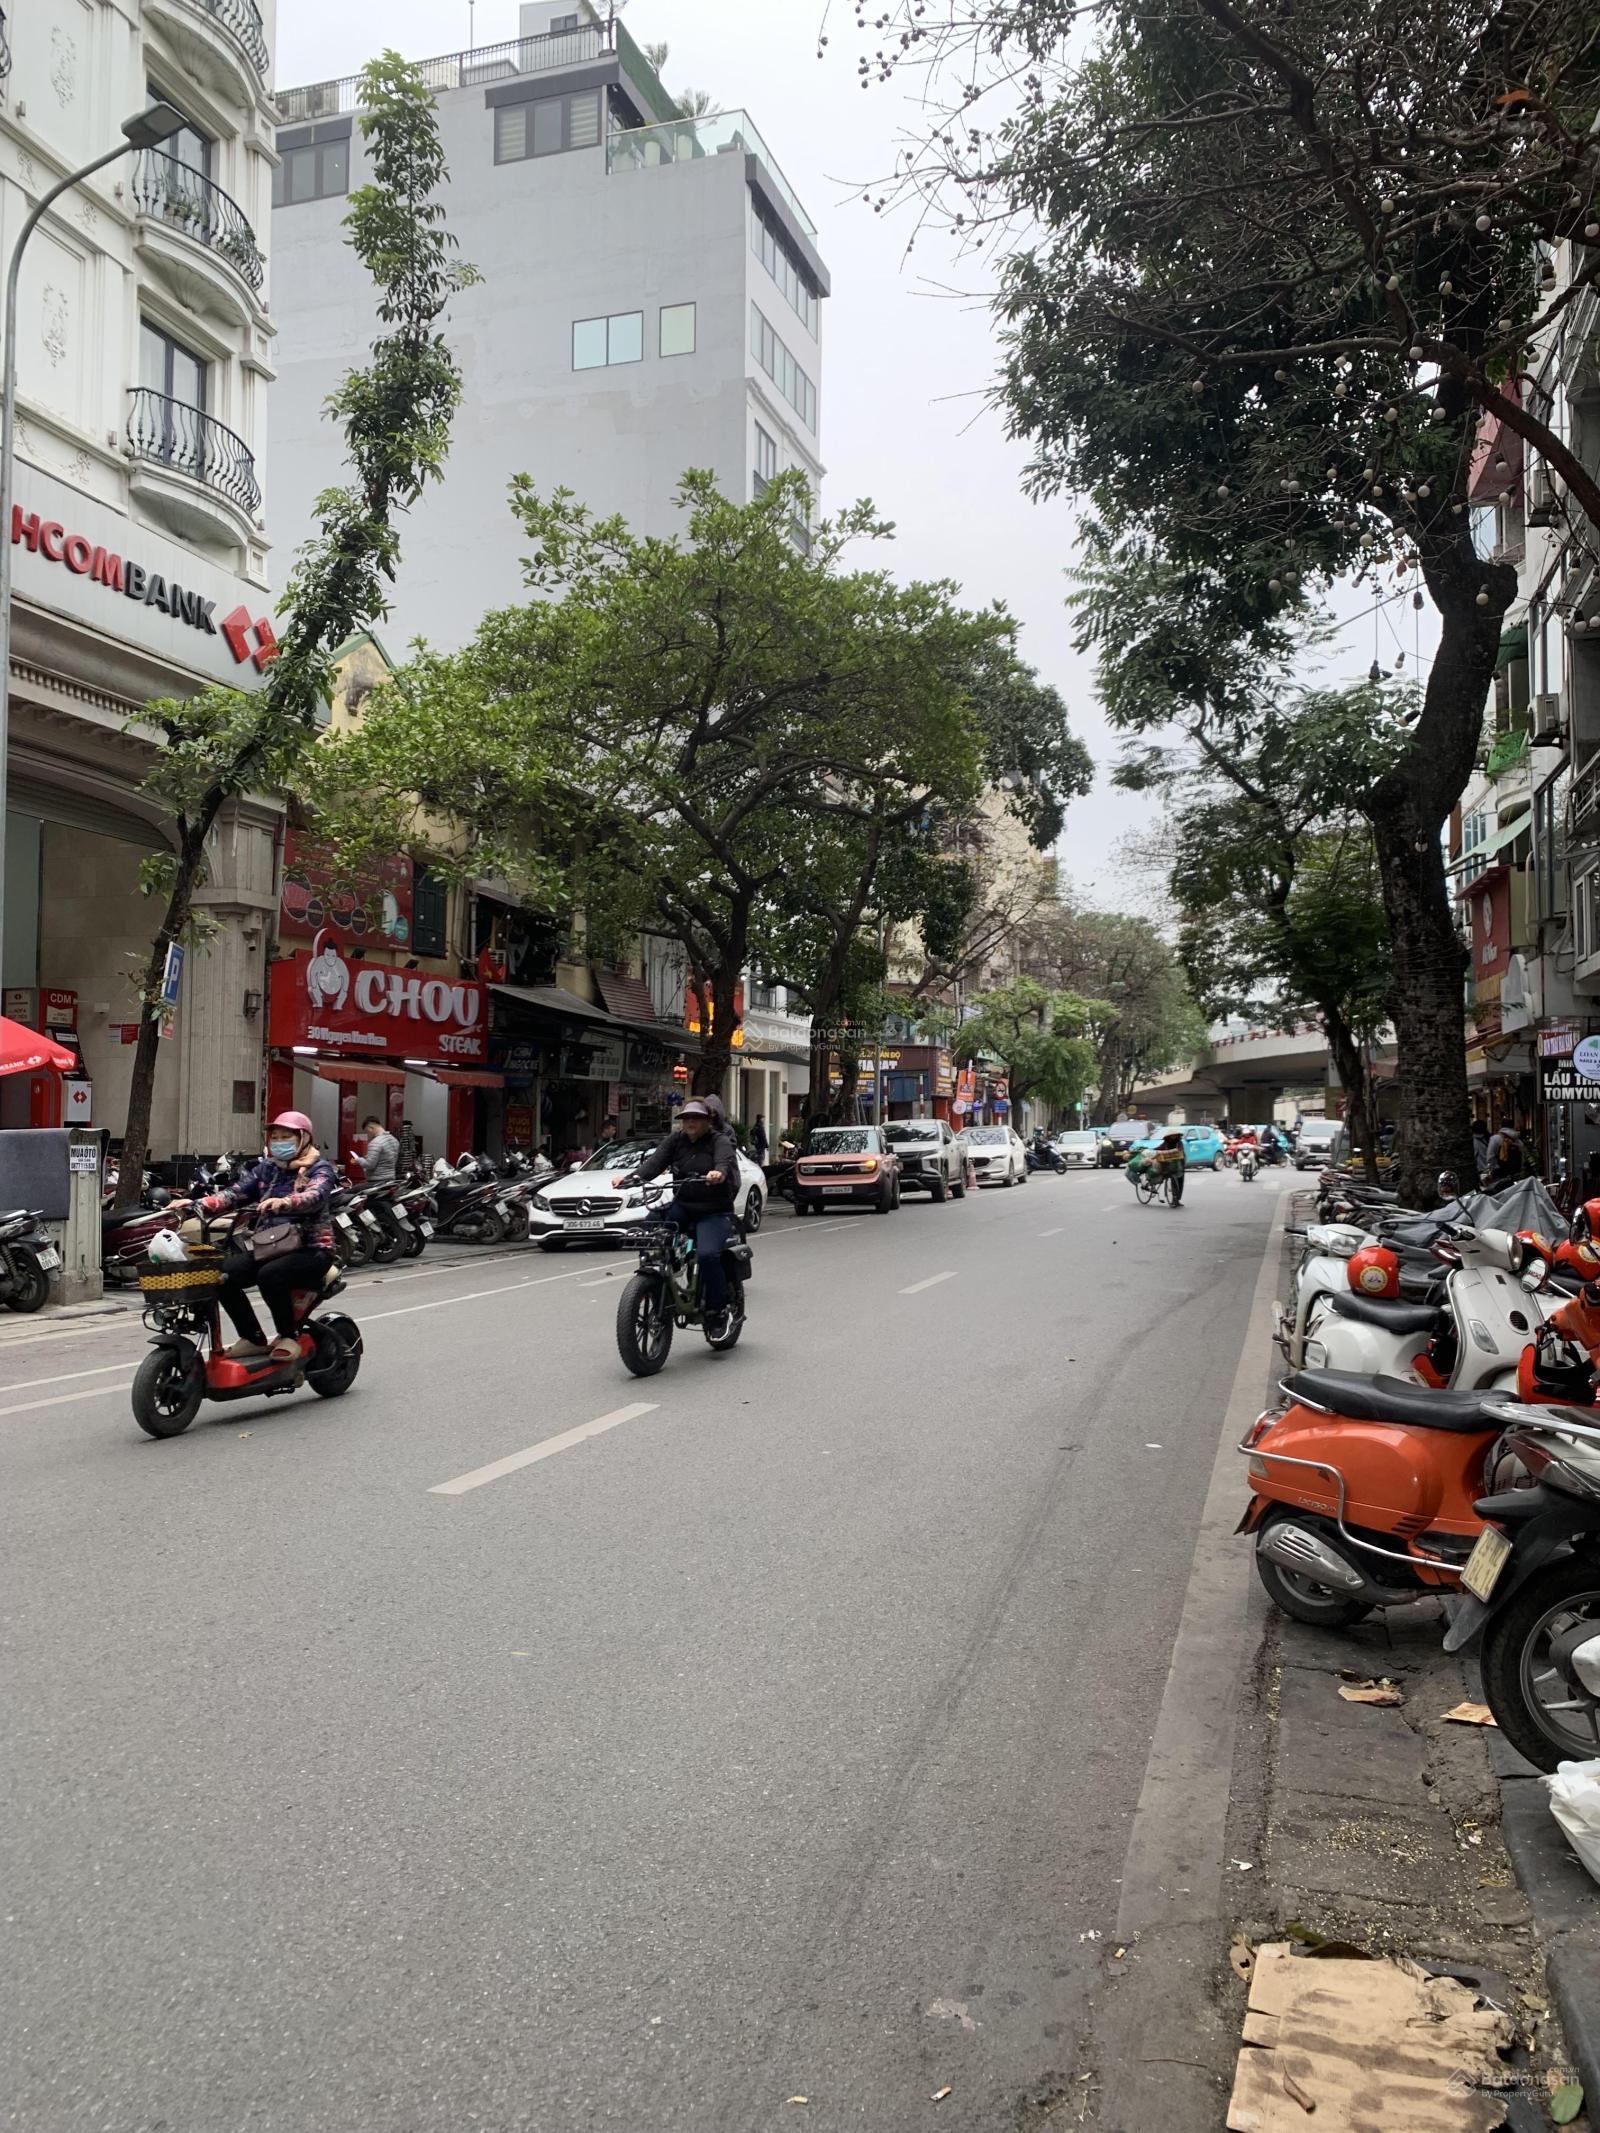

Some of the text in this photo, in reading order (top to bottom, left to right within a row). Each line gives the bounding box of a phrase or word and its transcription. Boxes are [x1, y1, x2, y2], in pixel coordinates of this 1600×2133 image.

[167, 957, 180, 994] P
[50, 993, 72, 1004] CDM
[355, 970, 479, 1026] CHOU
[438, 1034, 481, 1055] STEAK
[1544, 1068, 1571, 1086] LẨU
